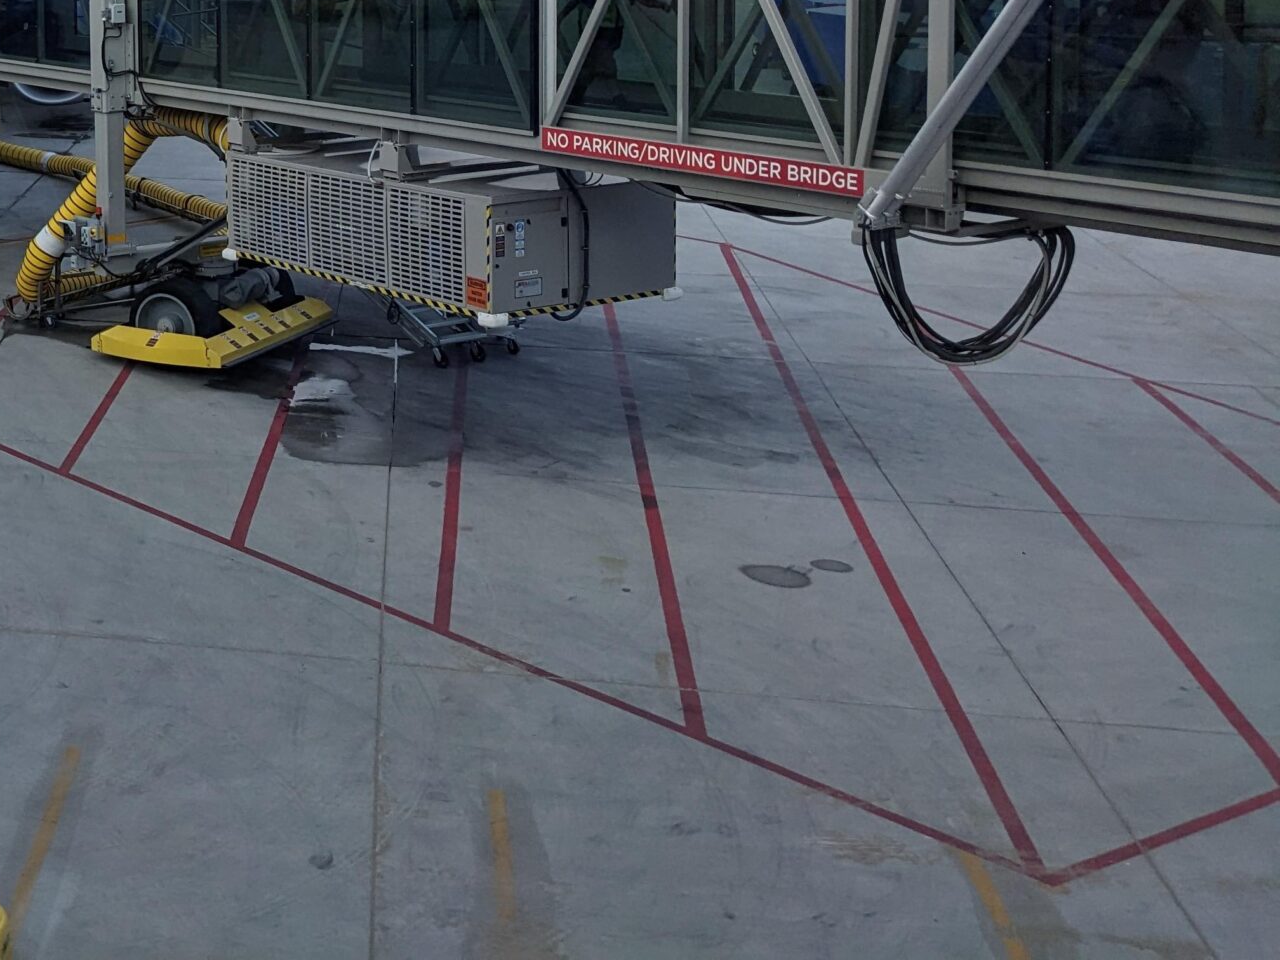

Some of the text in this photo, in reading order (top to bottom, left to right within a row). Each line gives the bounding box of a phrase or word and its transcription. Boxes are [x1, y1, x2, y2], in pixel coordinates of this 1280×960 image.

[547, 132, 858, 190] NO PARKING/DRIVING UNDER BRIDGE
